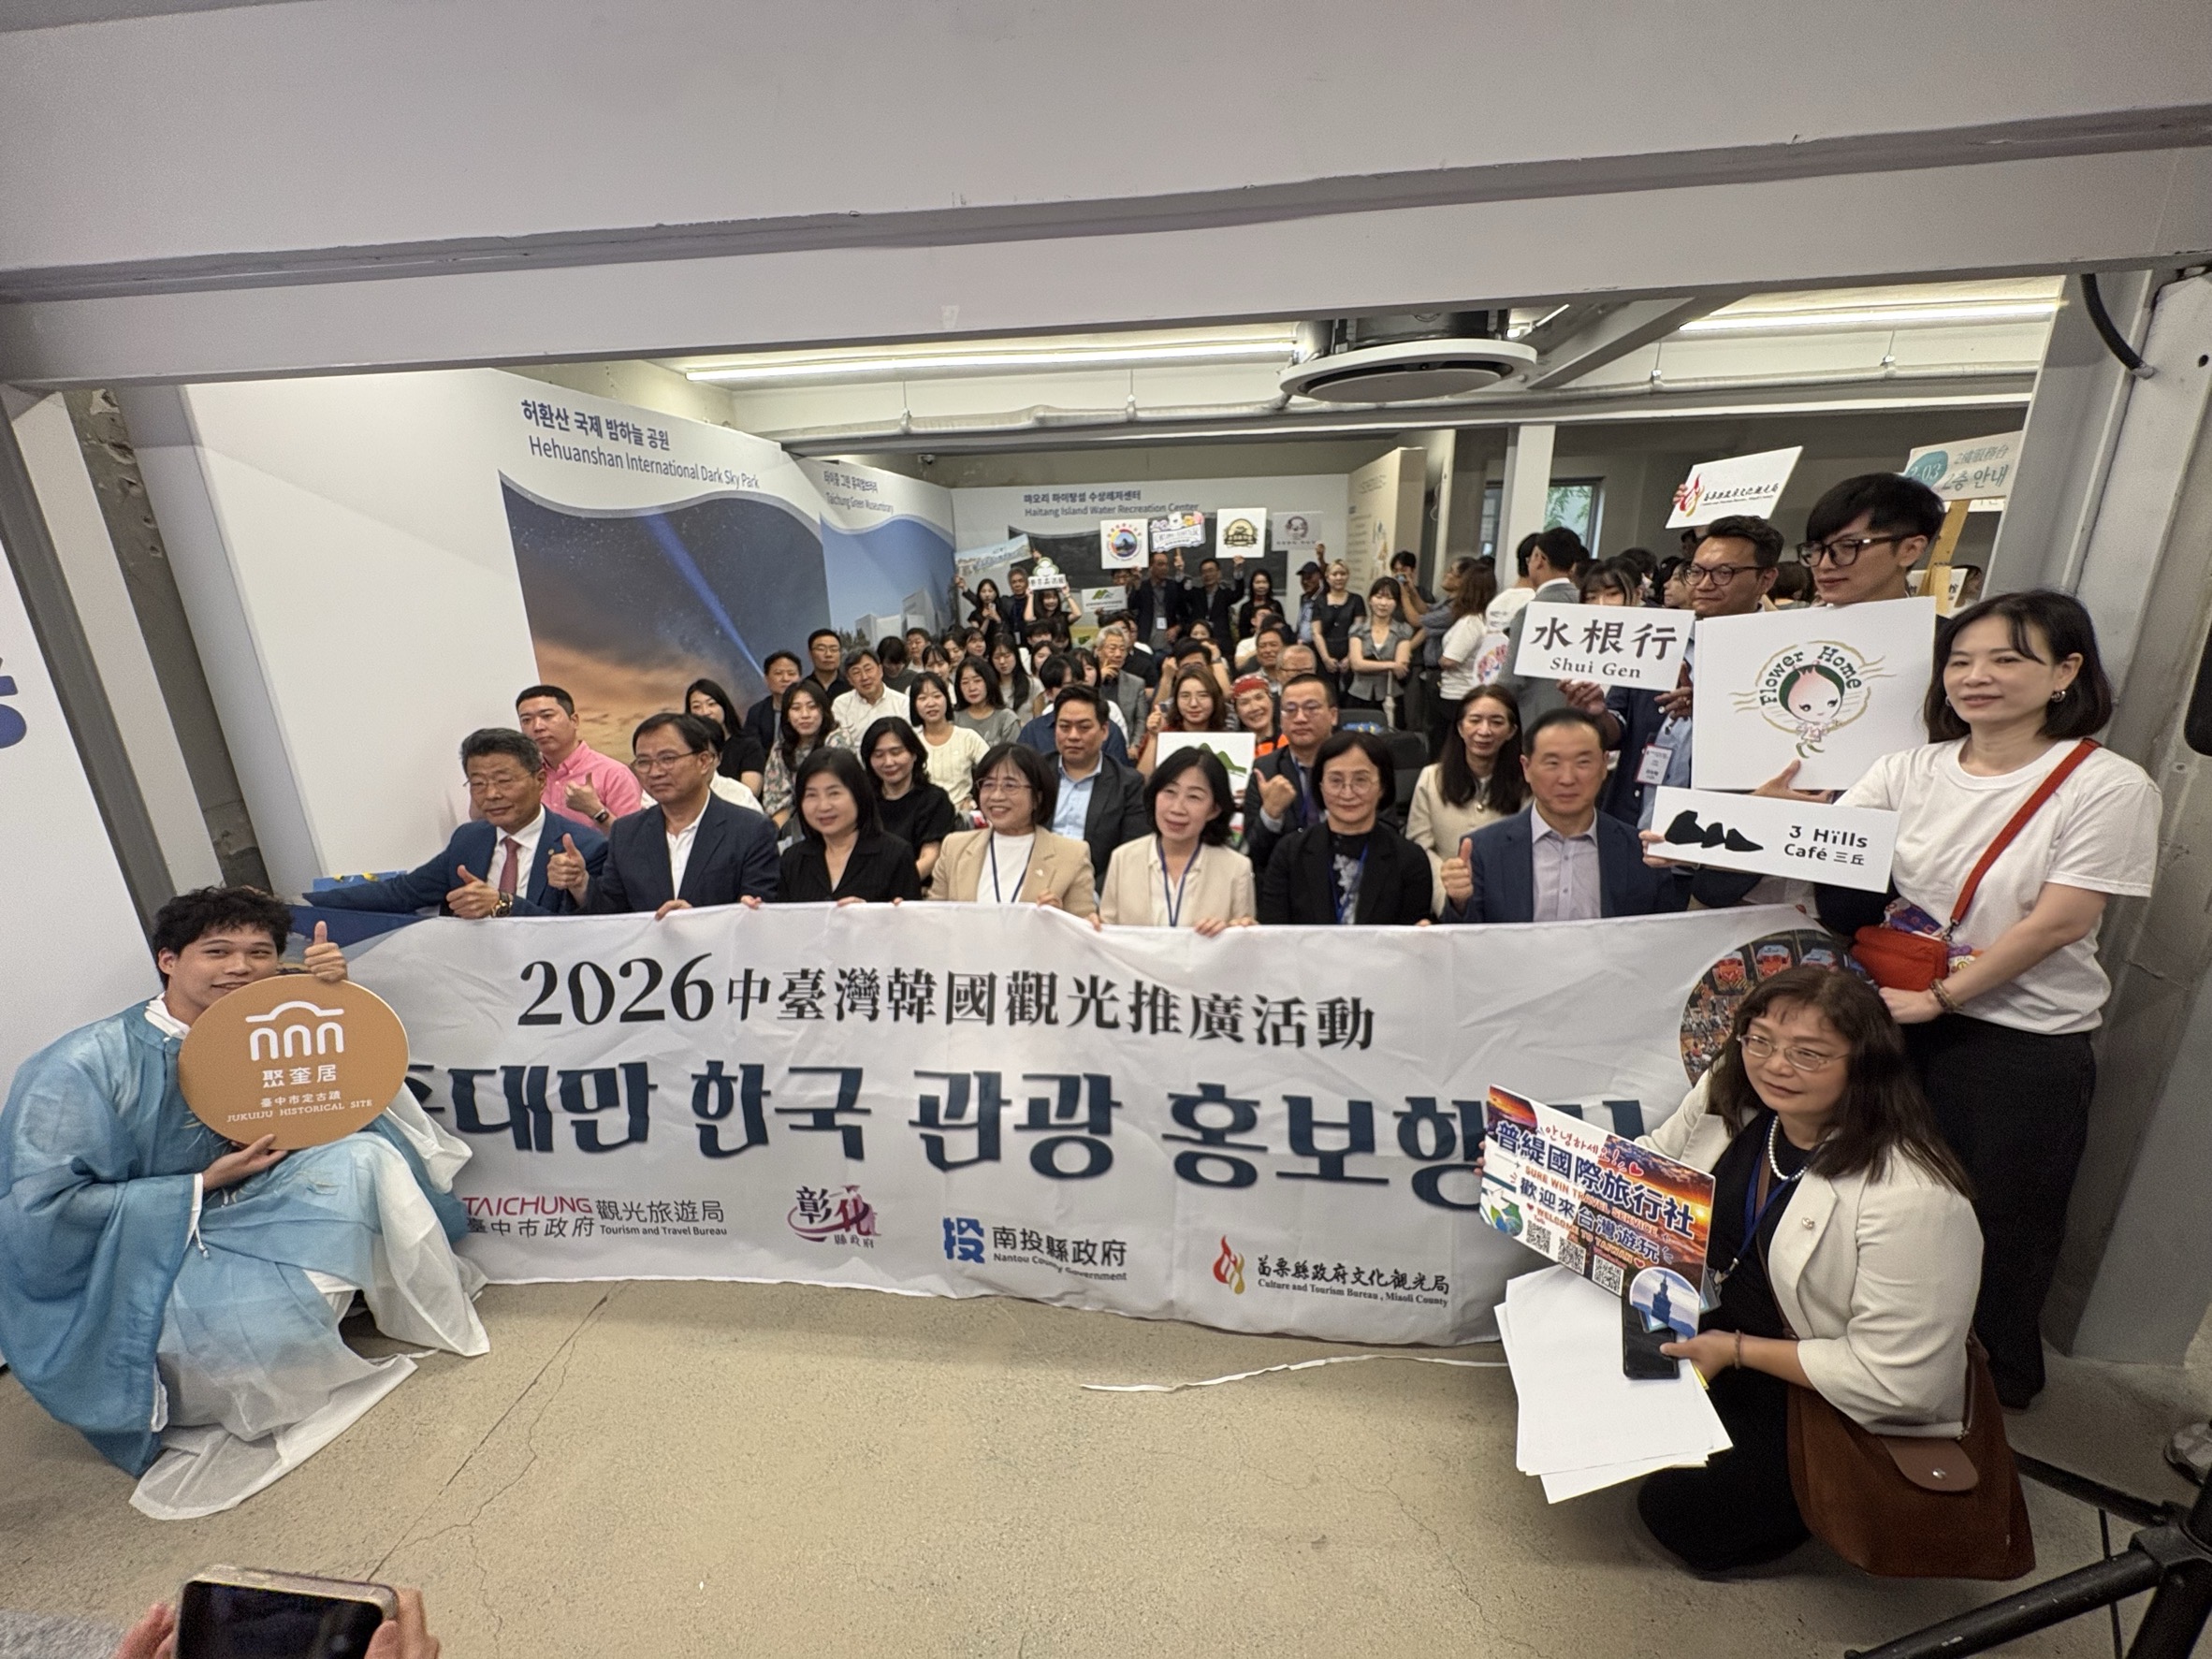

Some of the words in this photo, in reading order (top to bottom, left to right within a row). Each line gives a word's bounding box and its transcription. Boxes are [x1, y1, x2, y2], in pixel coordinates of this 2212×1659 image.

[521, 400, 570, 431] 허환산
[574, 411, 603, 438] 국제
[605, 418, 645, 446] 밤하늘
[648, 428, 670, 451] 공원
[530, 436, 624, 470] Hehuanshan
[626, 453, 700, 481] International
[701, 466, 723, 483] Dark
[724, 470, 740, 489] Sky
[741, 473, 760, 489] Park
[1973, 465, 2009, 488] 안내
[1025, 508, 1059, 517] Haitang
[1061, 506, 1088, 515] Island
[1090, 505, 1115, 515] Water
[1118, 503, 1166, 513] Recreation
[1168, 502, 1199, 512] Center
[1530, 617, 1678, 660] 水根行
[1550, 657, 1594, 674] Shui
[1602, 662, 1641, 678] Gen
[1760, 651, 1804, 706] Flower
[1817, 646, 1862, 690] Home
[1789, 825, 1802, 838] 3
[1784, 843, 1827, 861] Café
[1833, 851, 1865, 866] 三丘
[262, 1064, 337, 1089] 聚奎居
[226, 1110, 273, 1123] JUKUIJU
[281, 1103, 344, 1116] HISTORICAL
[350, 1099, 372, 1110] SITE
[260, 1090, 342, 1108] 臺中市定古蹟
[691, 1060, 871, 1160] 한국
[908, 1070, 1122, 1180] 관광
[1497, 1121, 1695, 1239] 普緹國際旅行社
[461, 1196, 592, 1216] TAICHUNG
[595, 1200, 724, 1224] 觀光旅遊局
[1525, 1165, 1549, 1184] SURE
[1550, 1176, 1569, 1193] WIN
[1572, 1187, 1610, 1214] TRAVEL
[1610, 1207, 1659, 1235] SERVICE
[468, 1216, 594, 1238] 臺中市政府
[600, 1224, 640, 1235] Tourism
[642, 1225, 660, 1235] and
[662, 1225, 691, 1236] Travel
[693, 1226, 727, 1236] Bureau
[1520, 1176, 1660, 1264] 歡迎來台灣遊玩
[992, 1226, 1127, 1267] 南投縣政府
[1536, 1207, 1579, 1235] WELCOME
[1580, 1229, 1594, 1242] TO
[1594, 1236, 1634, 1263] TAIWAN
[994, 1253, 1029, 1263] Nantou
[1258, 1279, 1289, 1290] Culture
[1291, 1282, 1308, 1291] and
[1310, 1284, 1345, 1297] Tourism
[1386, 1292, 1414, 1302] Miaoli
[1416, 1294, 1448, 1308] County
